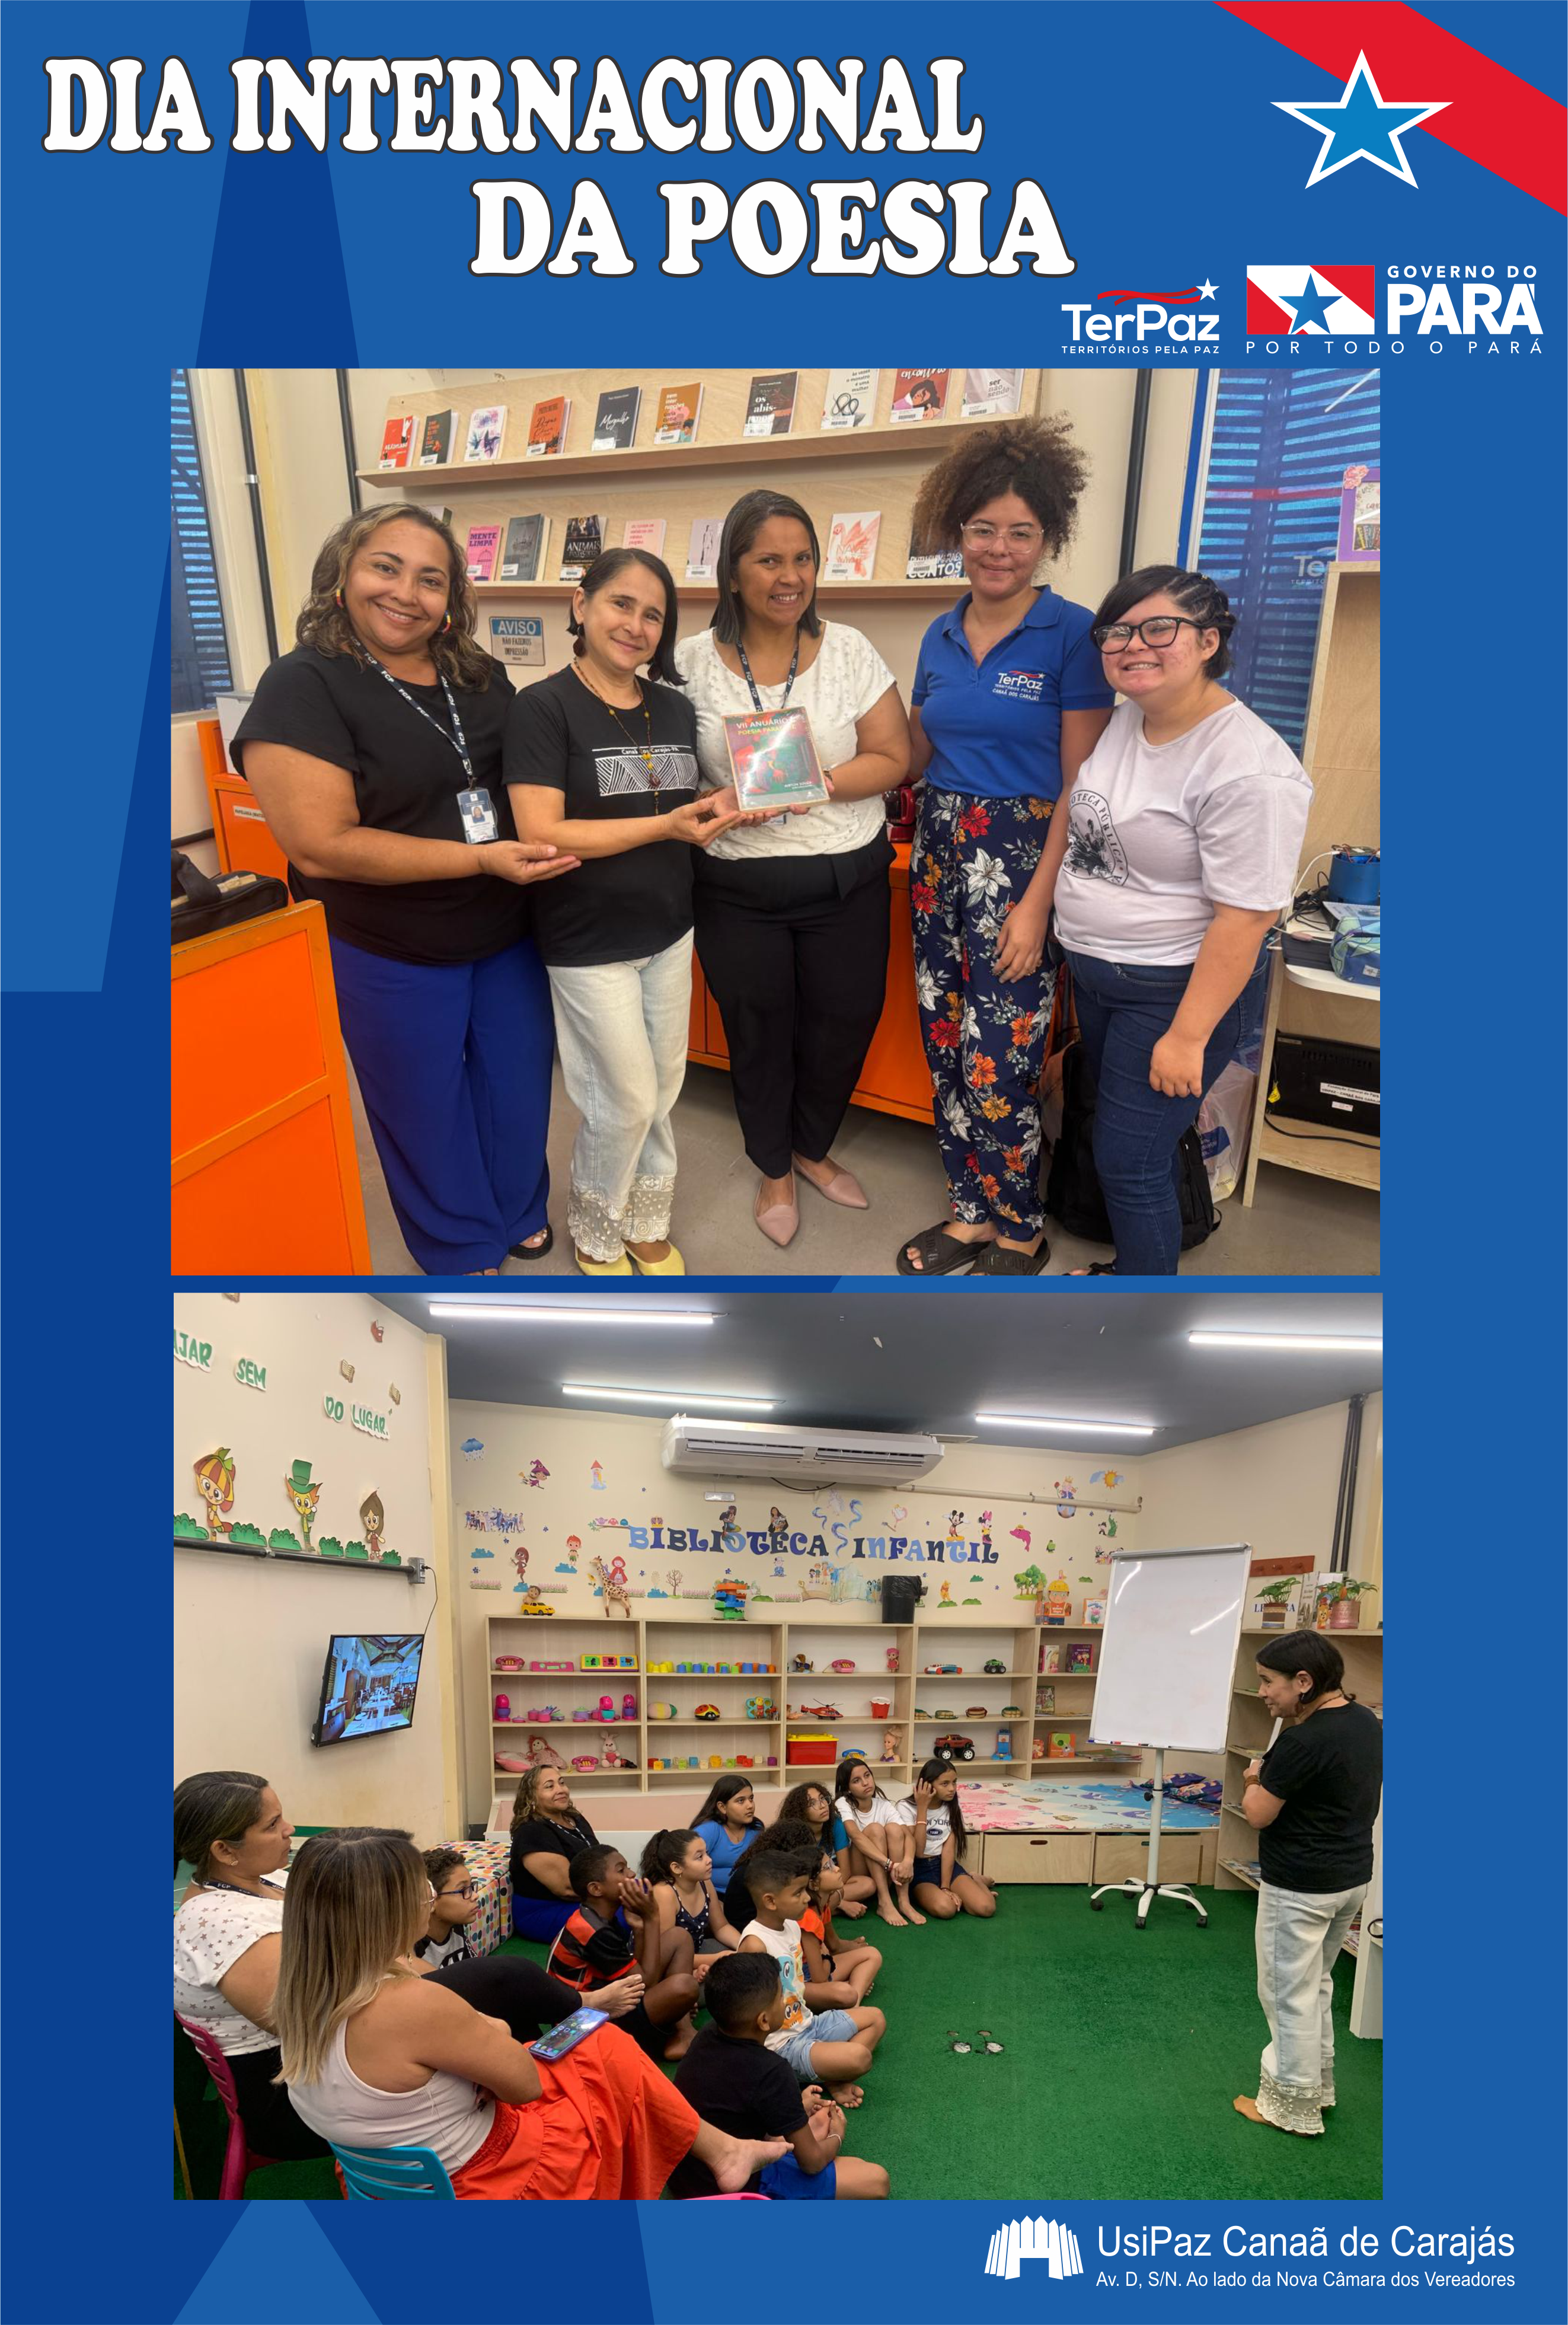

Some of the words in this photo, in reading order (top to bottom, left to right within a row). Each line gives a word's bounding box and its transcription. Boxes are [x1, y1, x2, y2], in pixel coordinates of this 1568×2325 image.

[498, 620, 537, 635] AVISO
[998, 672, 1043, 691] TerPaz
[237, 1358, 266, 1389] SEM
[325, 1396, 344, 1421] DO
[629, 1525, 829, 1558] BIBLIOTECA
[851, 1536, 999, 1564] INFANTIL
